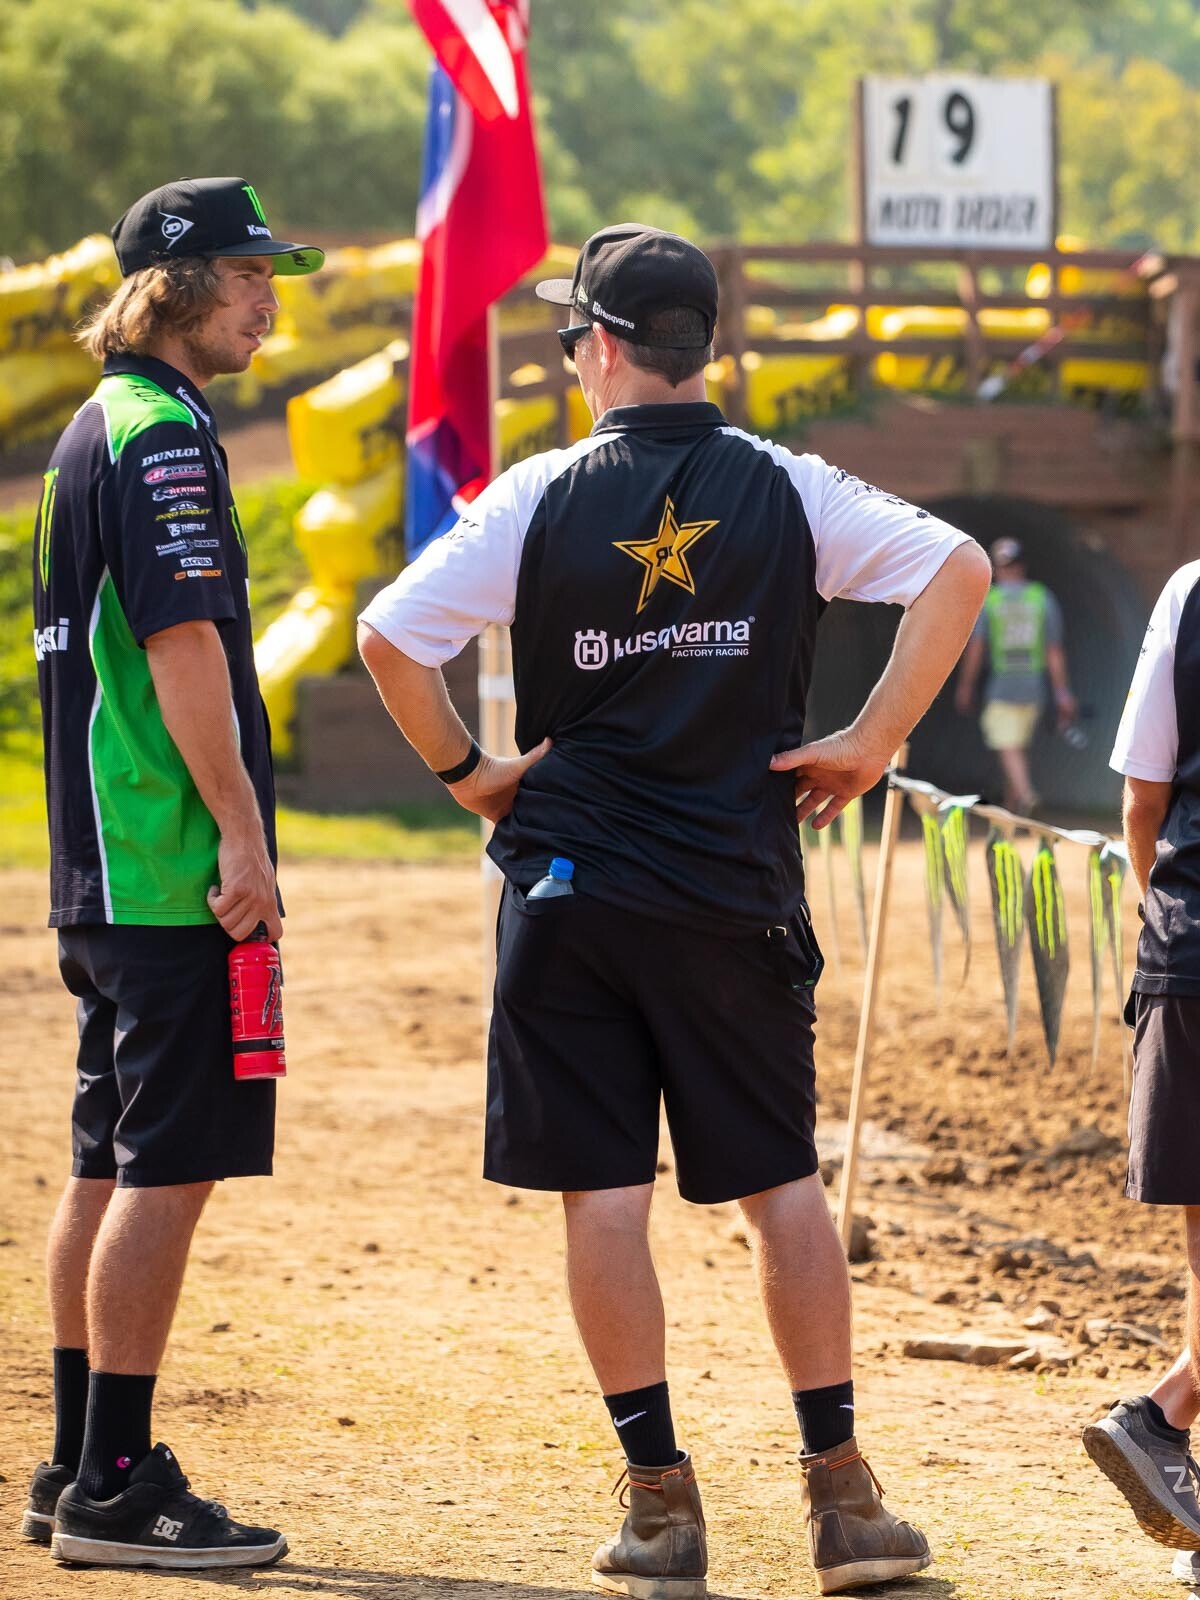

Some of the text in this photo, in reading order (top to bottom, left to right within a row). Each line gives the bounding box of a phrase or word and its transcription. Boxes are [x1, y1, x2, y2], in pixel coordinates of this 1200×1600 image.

[600, 308, 635, 330] Husqvarna
[168, 486, 206, 495] RENTHAL
[672, 648, 749, 658] FACTORY RACING
[152, 1515, 184, 1541] DC
